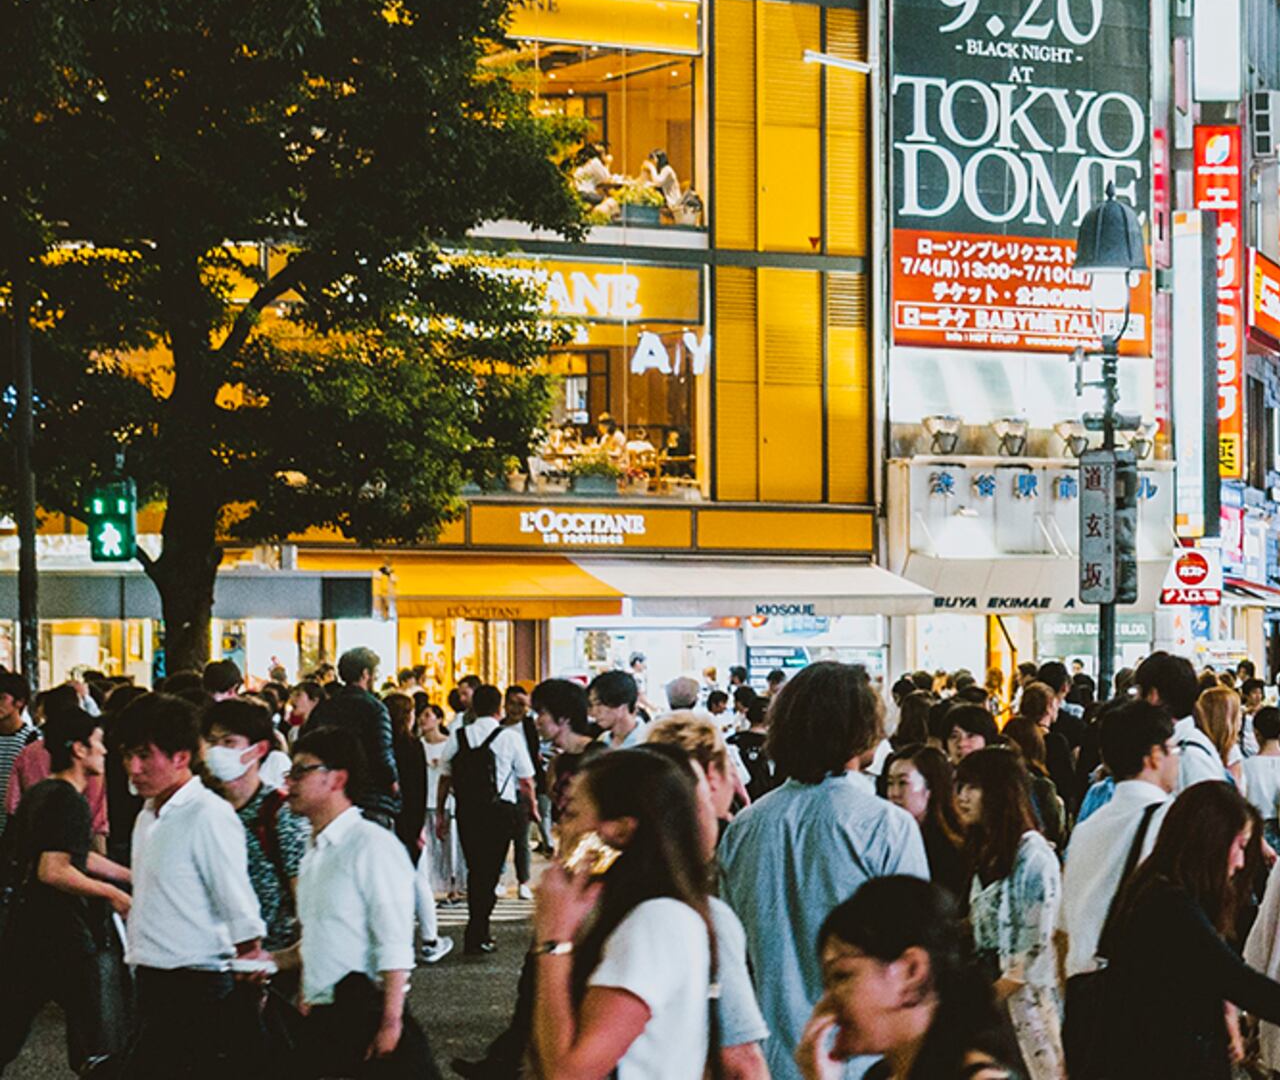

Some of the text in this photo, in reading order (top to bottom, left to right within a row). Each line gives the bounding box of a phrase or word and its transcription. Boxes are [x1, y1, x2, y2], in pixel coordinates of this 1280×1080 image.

[966, 40, 1074, 63] BLACK NIGHT
[1008, 66, 1034, 84] AT
[892, 74, 1145, 159] TOKYO
[894, 141, 1142, 228] DOME
[930, 472, 1158, 500] 渋谷駅前ル
[519, 508, 645, 535] L'OCCITANE
[1083, 466, 1107, 590] 道玄坂
[755, 603, 816, 617] KIOSQUE
[933, 597, 977, 609] BUYA
[987, 597, 1052, 609] EKIMAE
